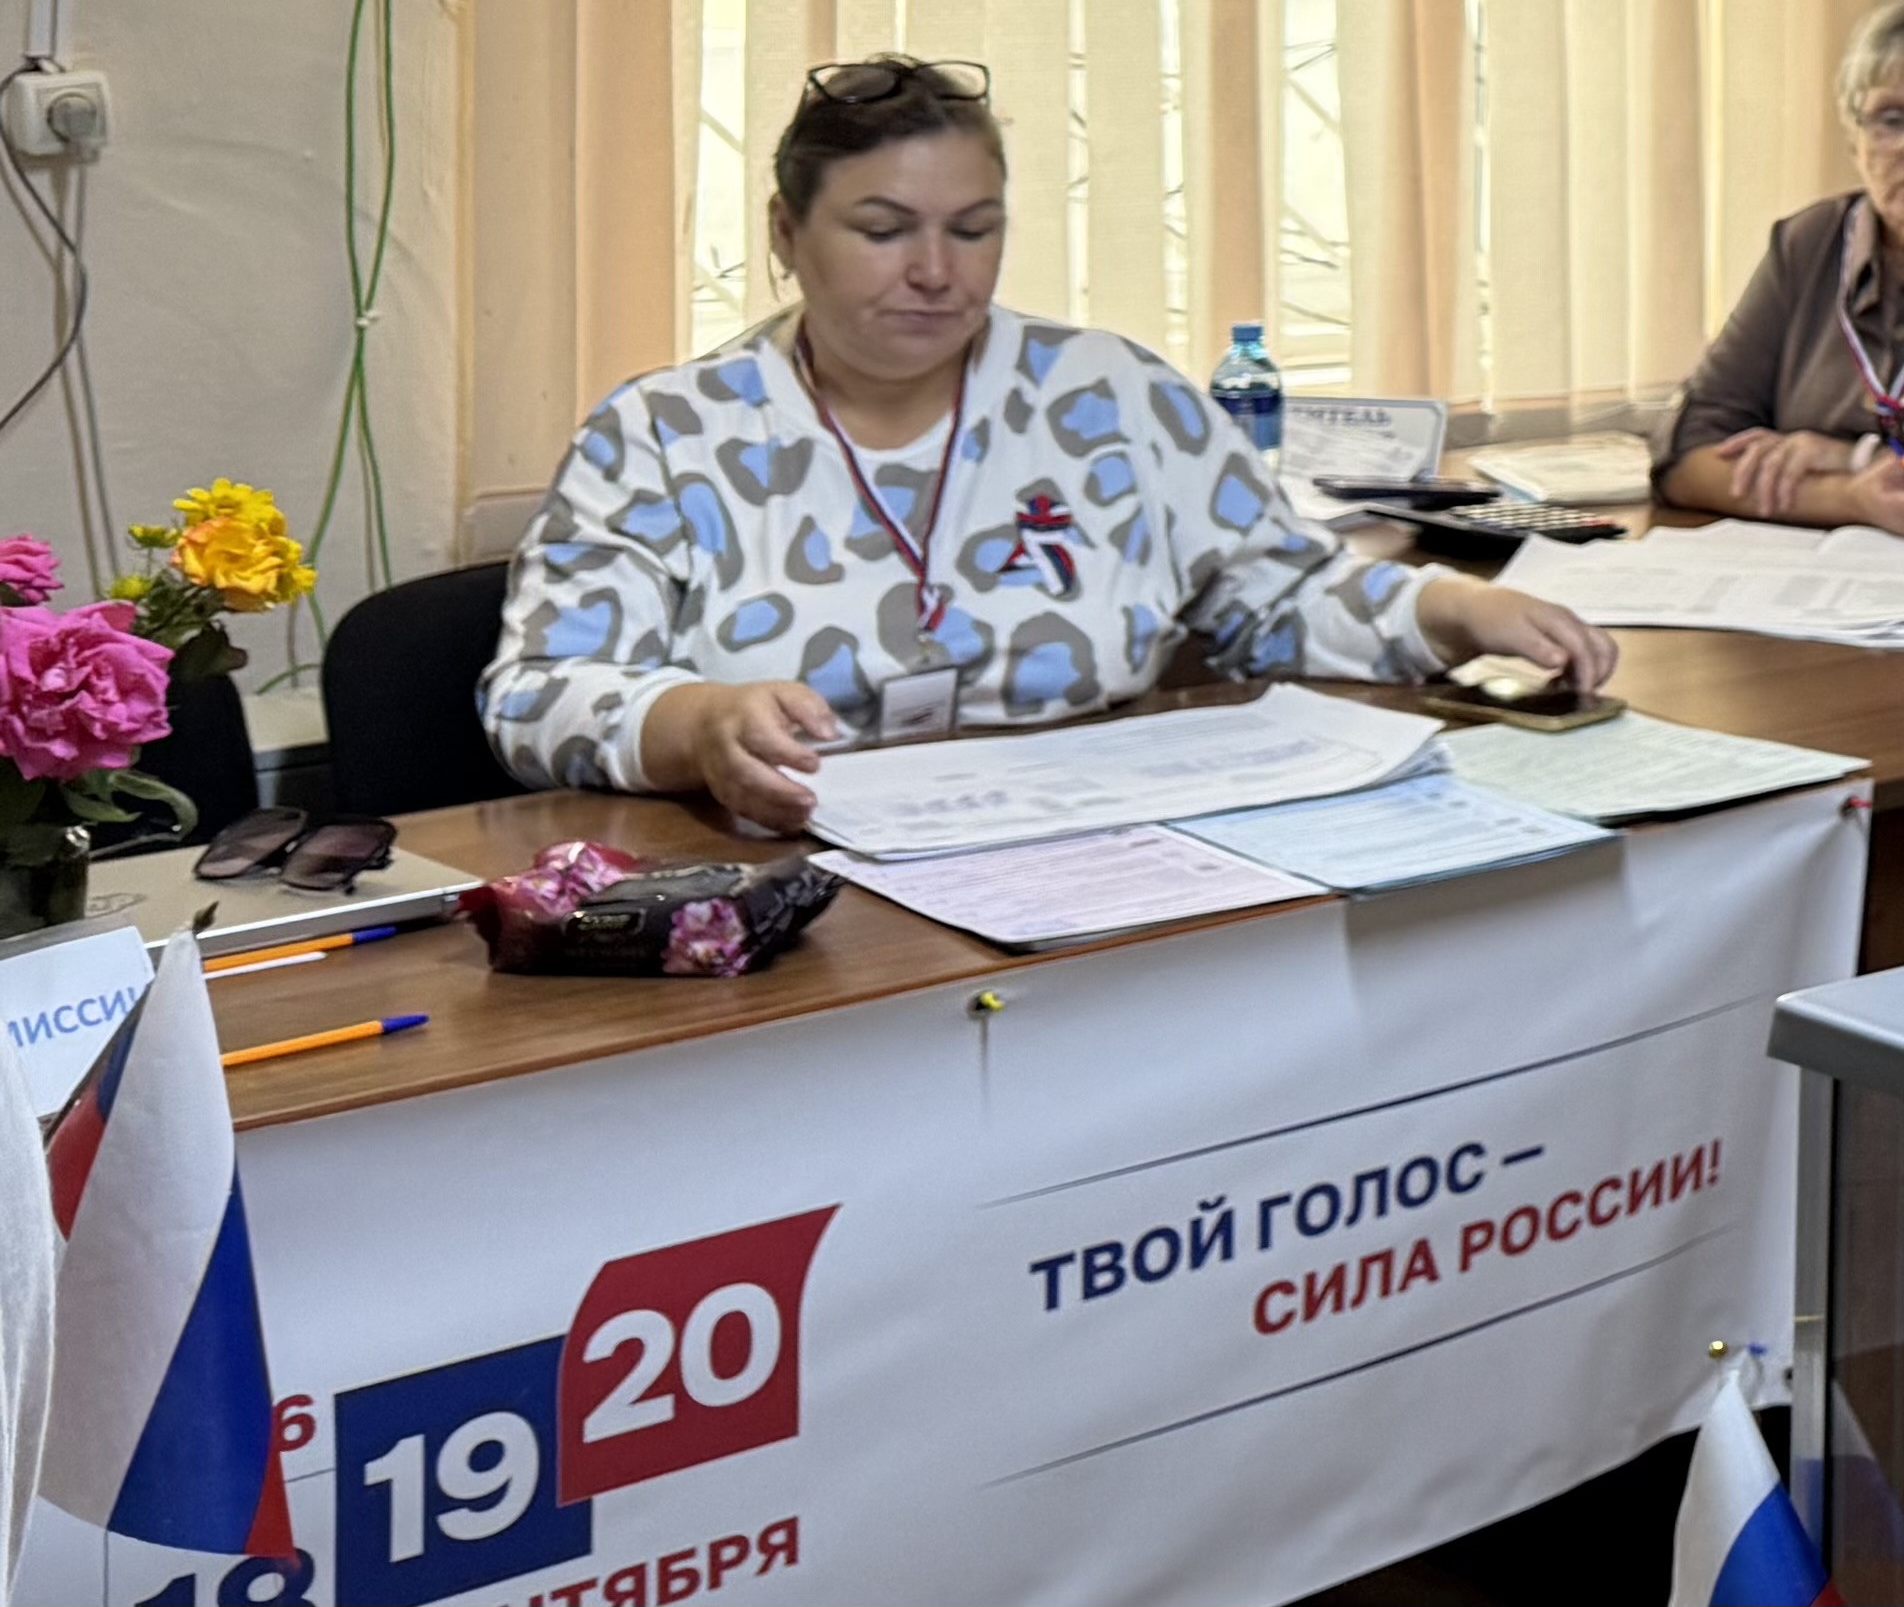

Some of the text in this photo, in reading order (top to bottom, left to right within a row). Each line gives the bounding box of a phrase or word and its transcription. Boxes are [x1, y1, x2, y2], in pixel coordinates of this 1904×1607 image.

[7, 987, 137, 1047] ИССИ
[1030, 1200, 1236, 1312] ТВОЙ
[1258, 1141, 1488, 1251] ГОЛОС
[1252, 1139, 1722, 1335] СИЛА РОССИИ!
[364, 1411, 540, 1563] 19
[582, 1282, 782, 1443] 20
